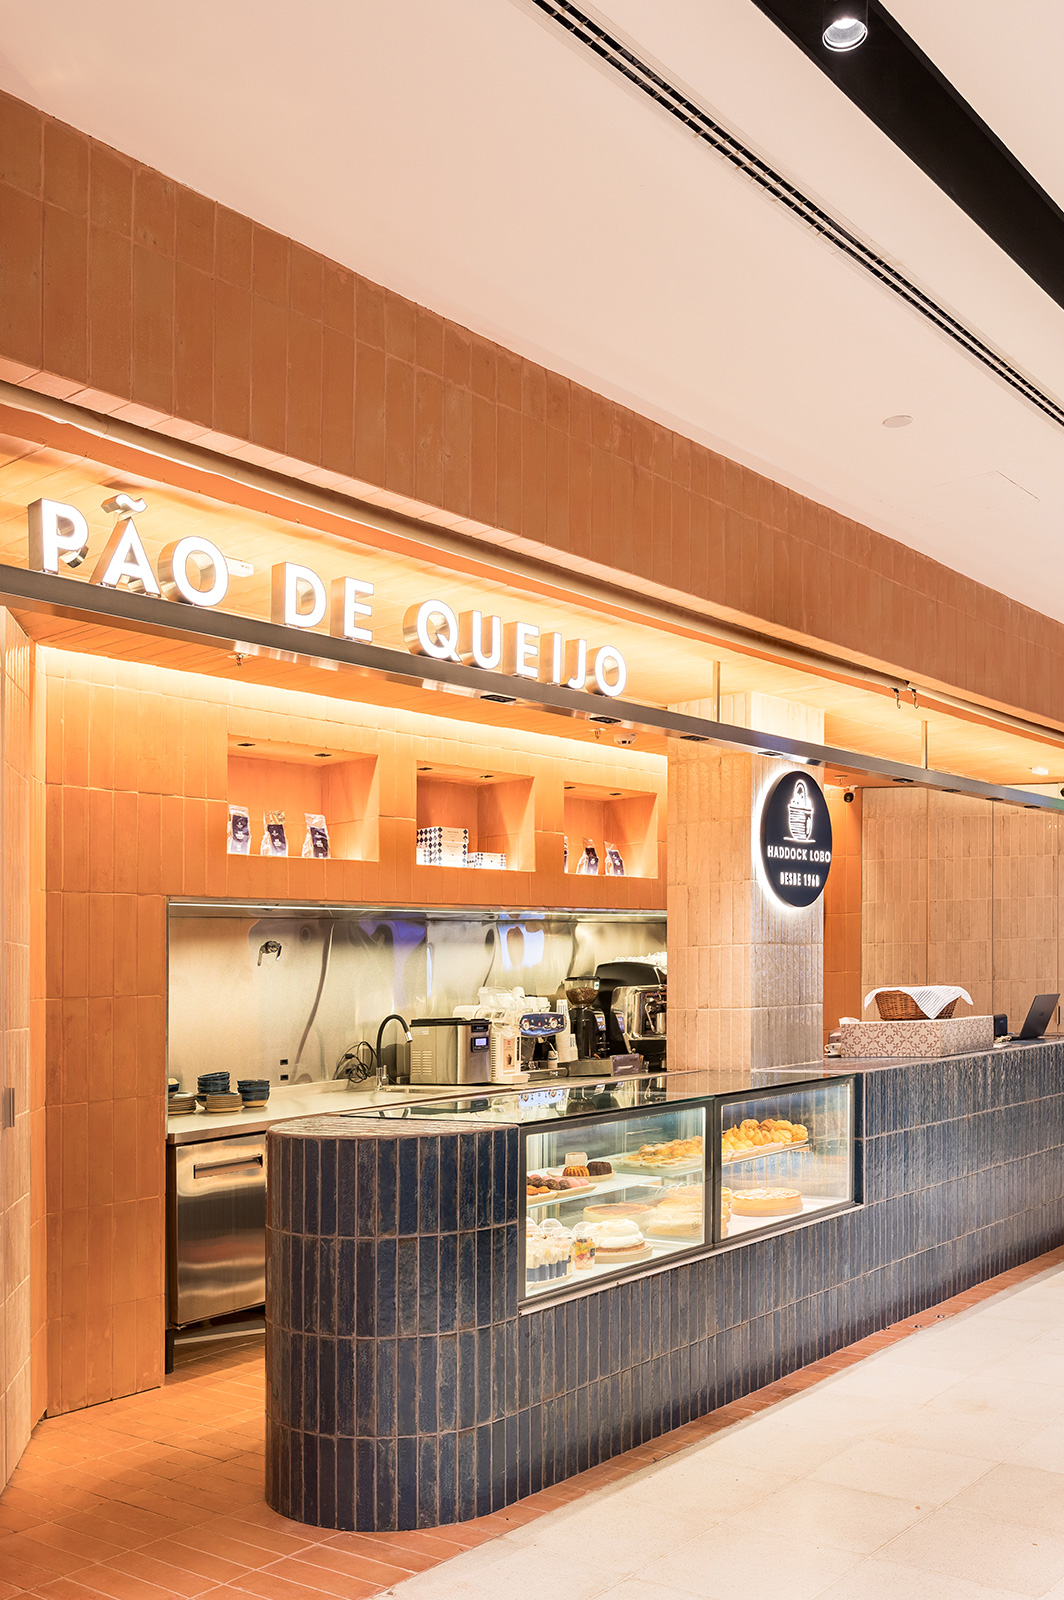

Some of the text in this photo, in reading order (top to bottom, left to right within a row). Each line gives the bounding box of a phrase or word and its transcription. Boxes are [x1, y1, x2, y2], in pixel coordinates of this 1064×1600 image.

[38, 493, 627, 697] PÃO DE QUEIJO
[767, 845, 831, 863] HADDOCK LOBO
[779, 871, 802, 887] DESDE
